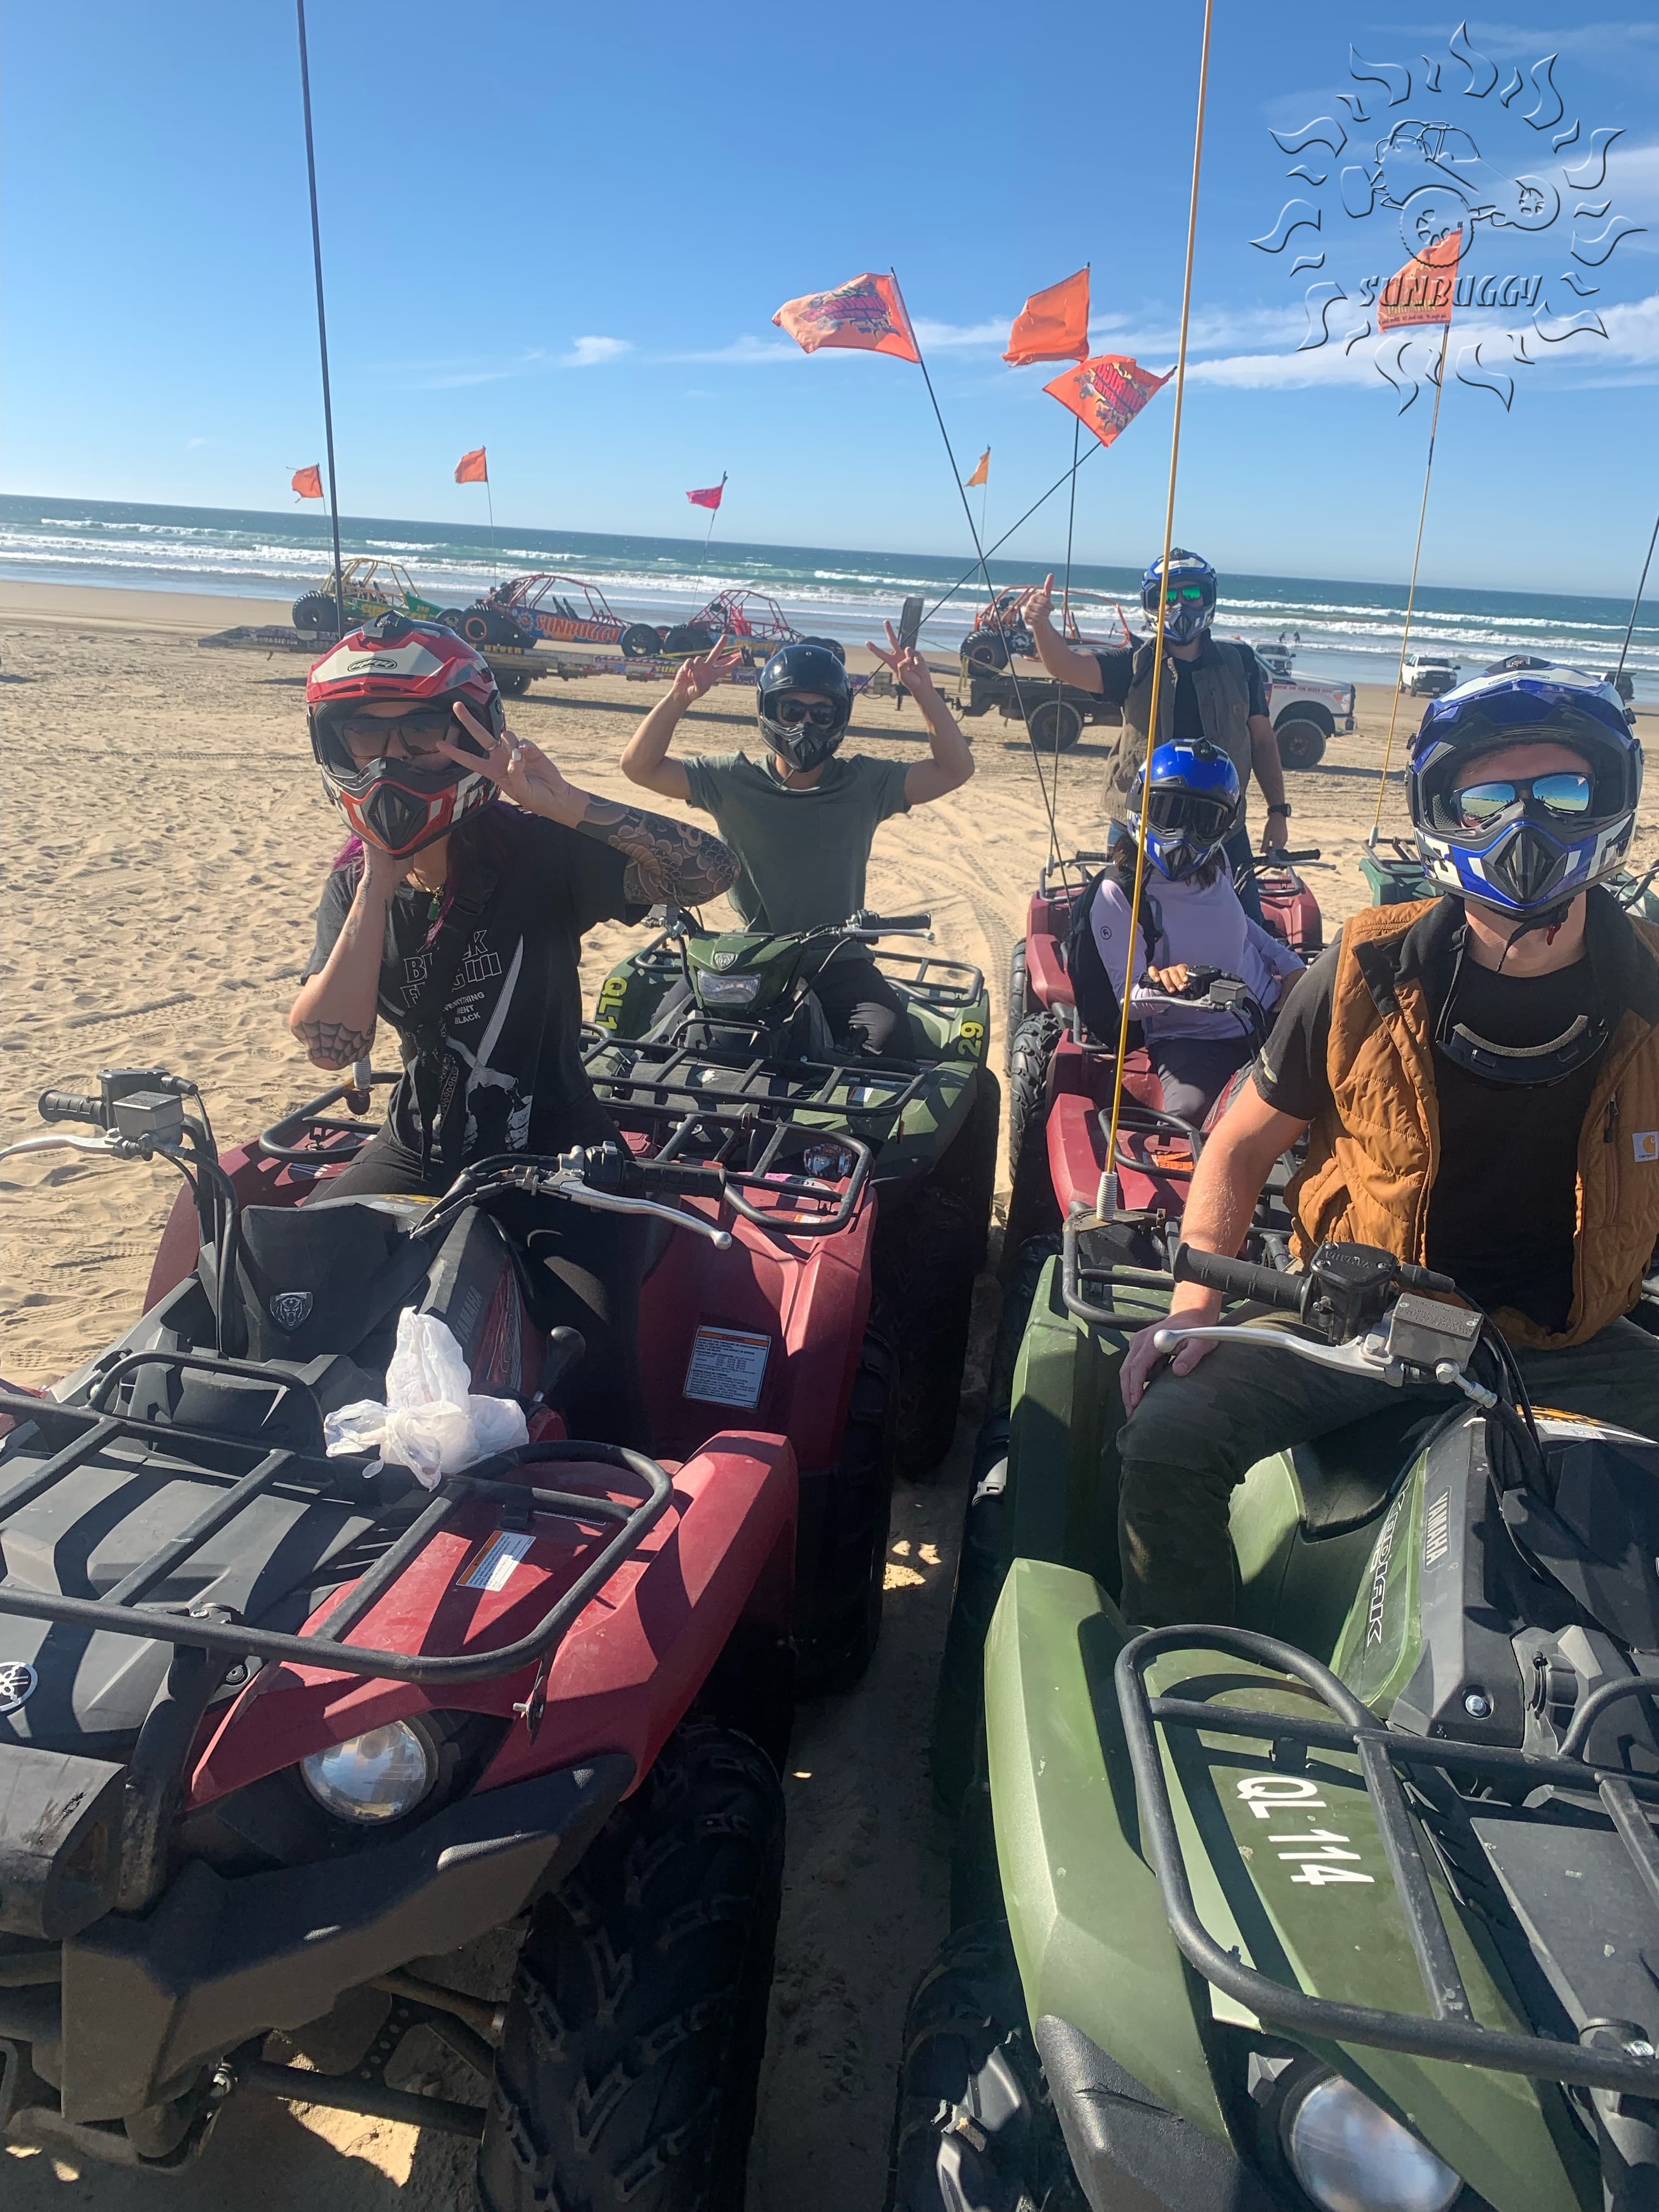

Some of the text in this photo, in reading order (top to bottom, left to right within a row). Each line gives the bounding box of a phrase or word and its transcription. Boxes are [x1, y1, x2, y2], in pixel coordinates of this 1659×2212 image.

[536, 614, 622, 644] SUNBUGGY
[443, 991, 486, 1012] VERYTHING
[454, 1012, 481, 1024] BLACK
[1426, 1491, 1448, 1567] YAMAHA
[1367, 1478, 1412, 1647] KODIAK
